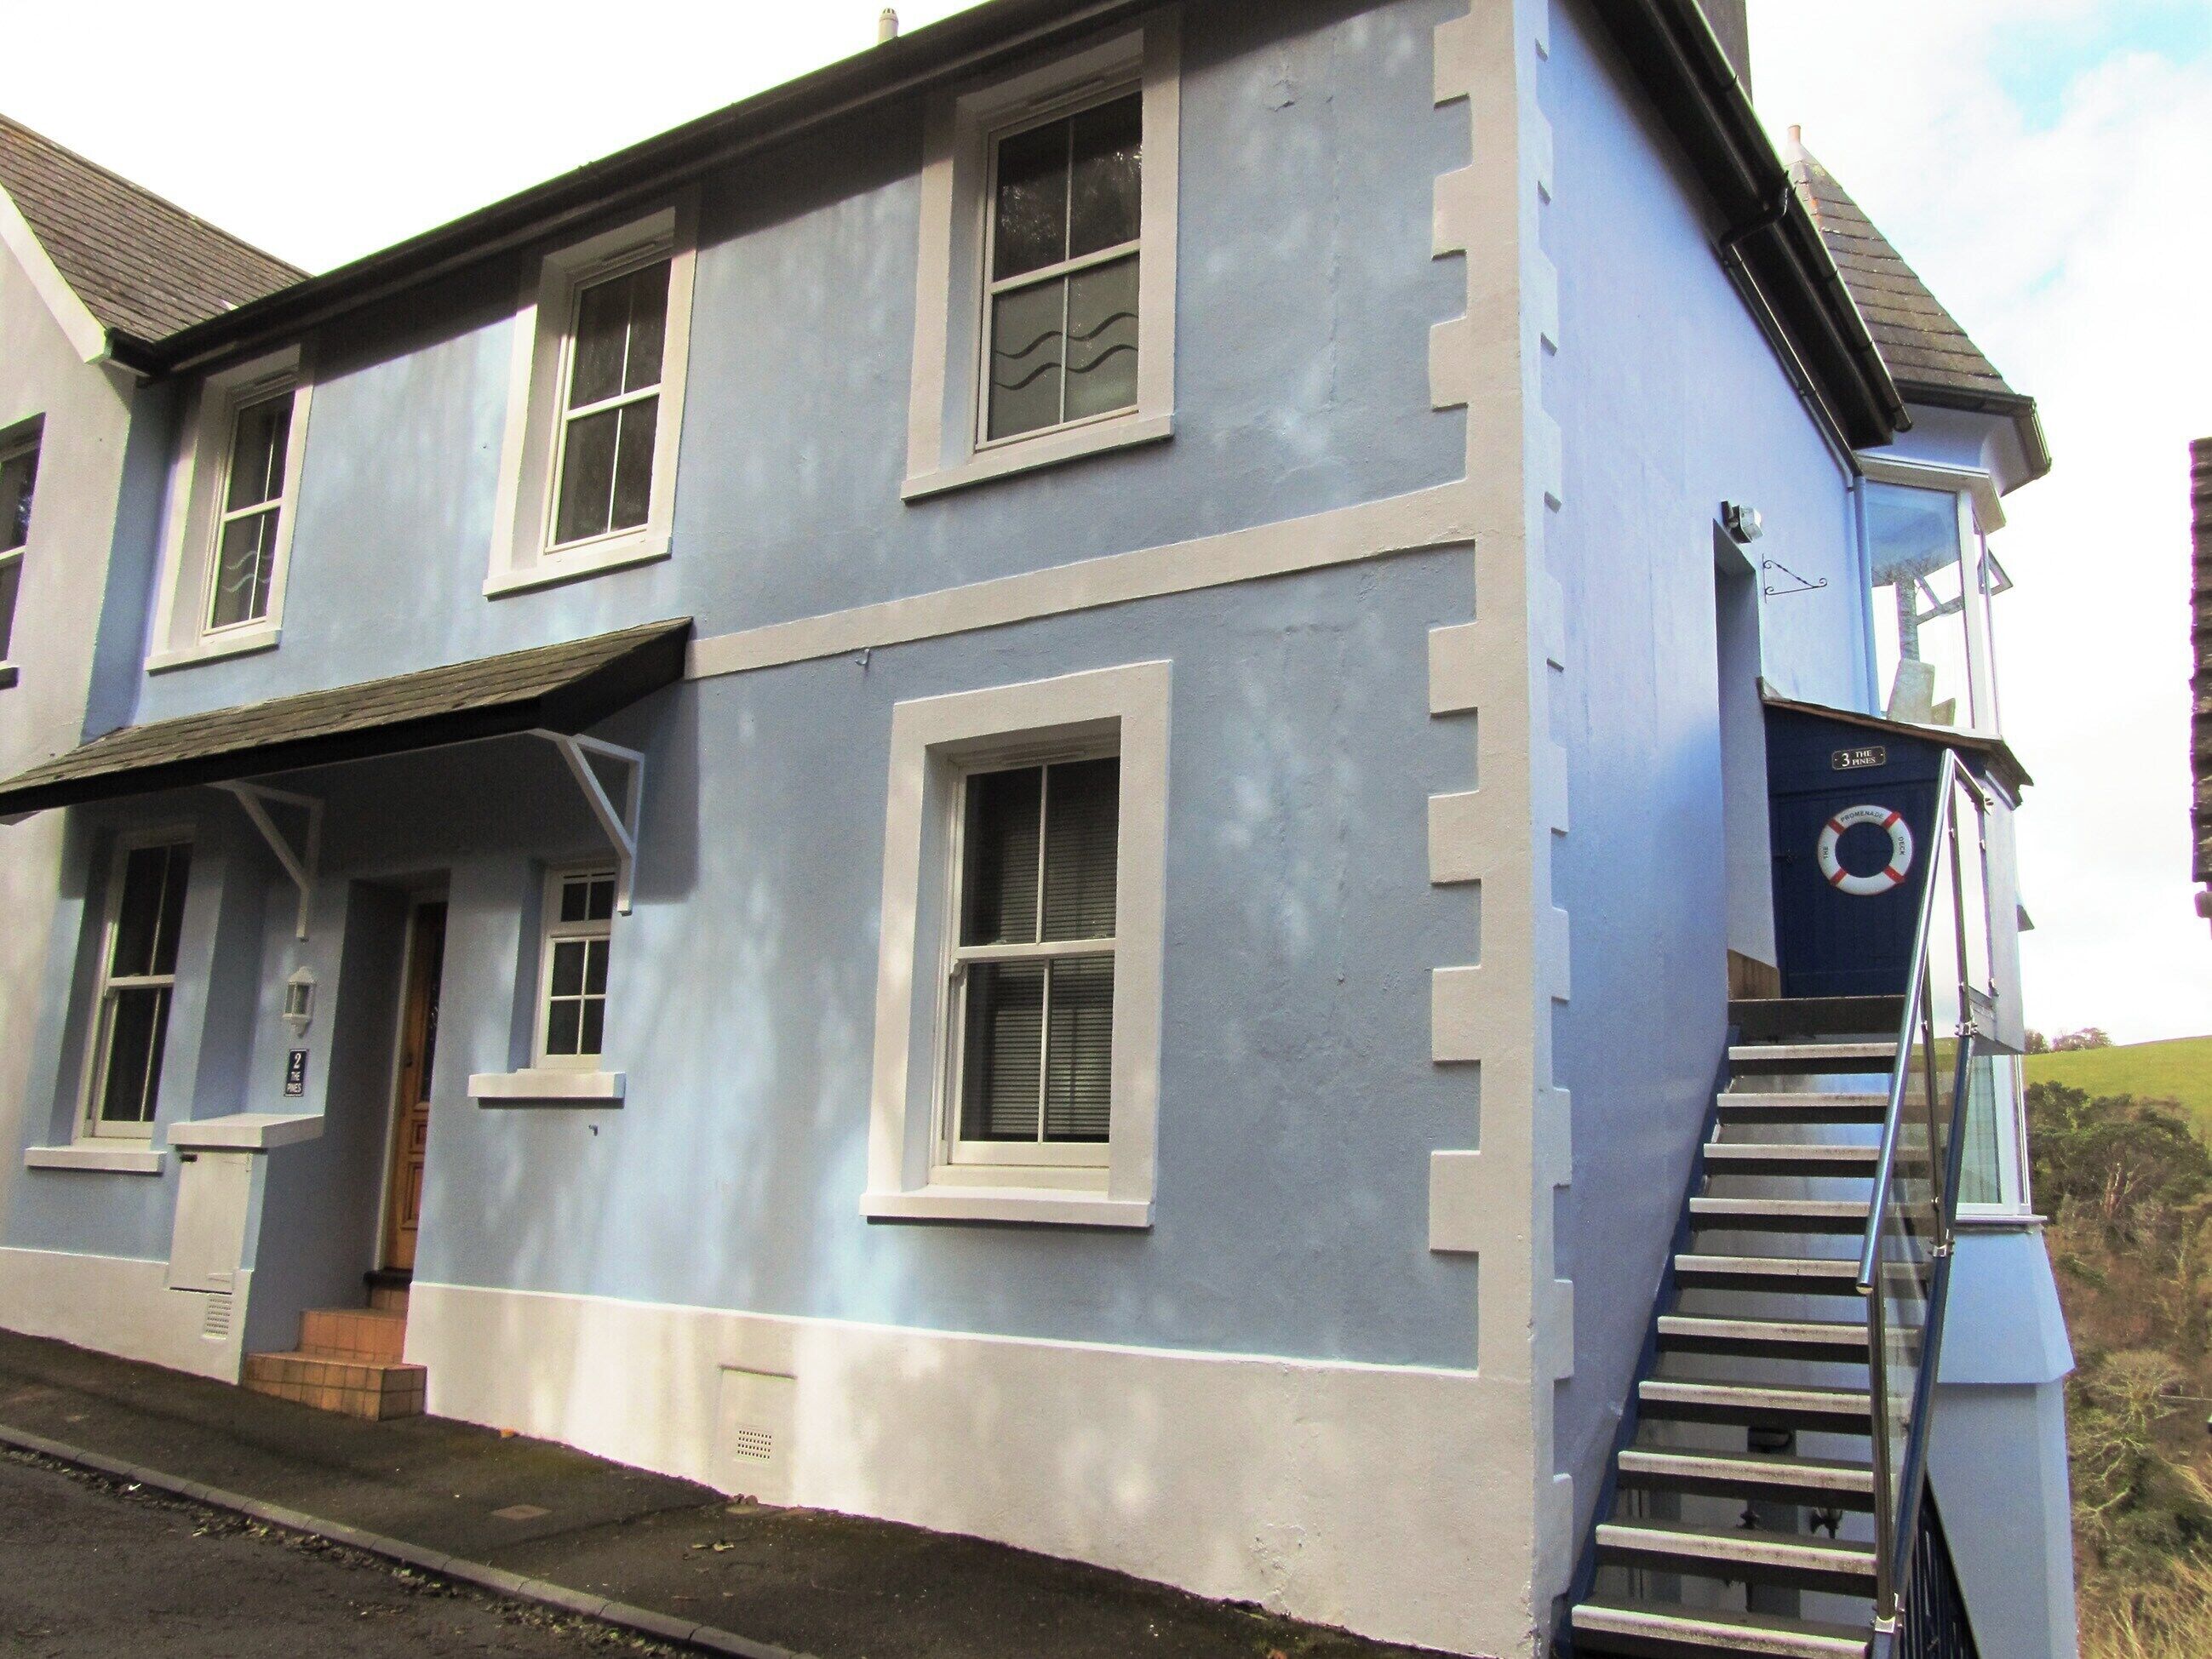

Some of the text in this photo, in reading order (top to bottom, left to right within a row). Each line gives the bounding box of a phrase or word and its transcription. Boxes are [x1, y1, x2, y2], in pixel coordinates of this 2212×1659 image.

[1842, 752, 1850, 767] 3
[1840, 810, 1884, 822] PROMENADE
[1898, 836, 1906, 855] DECK
[294, 1053, 301, 1069] 2
